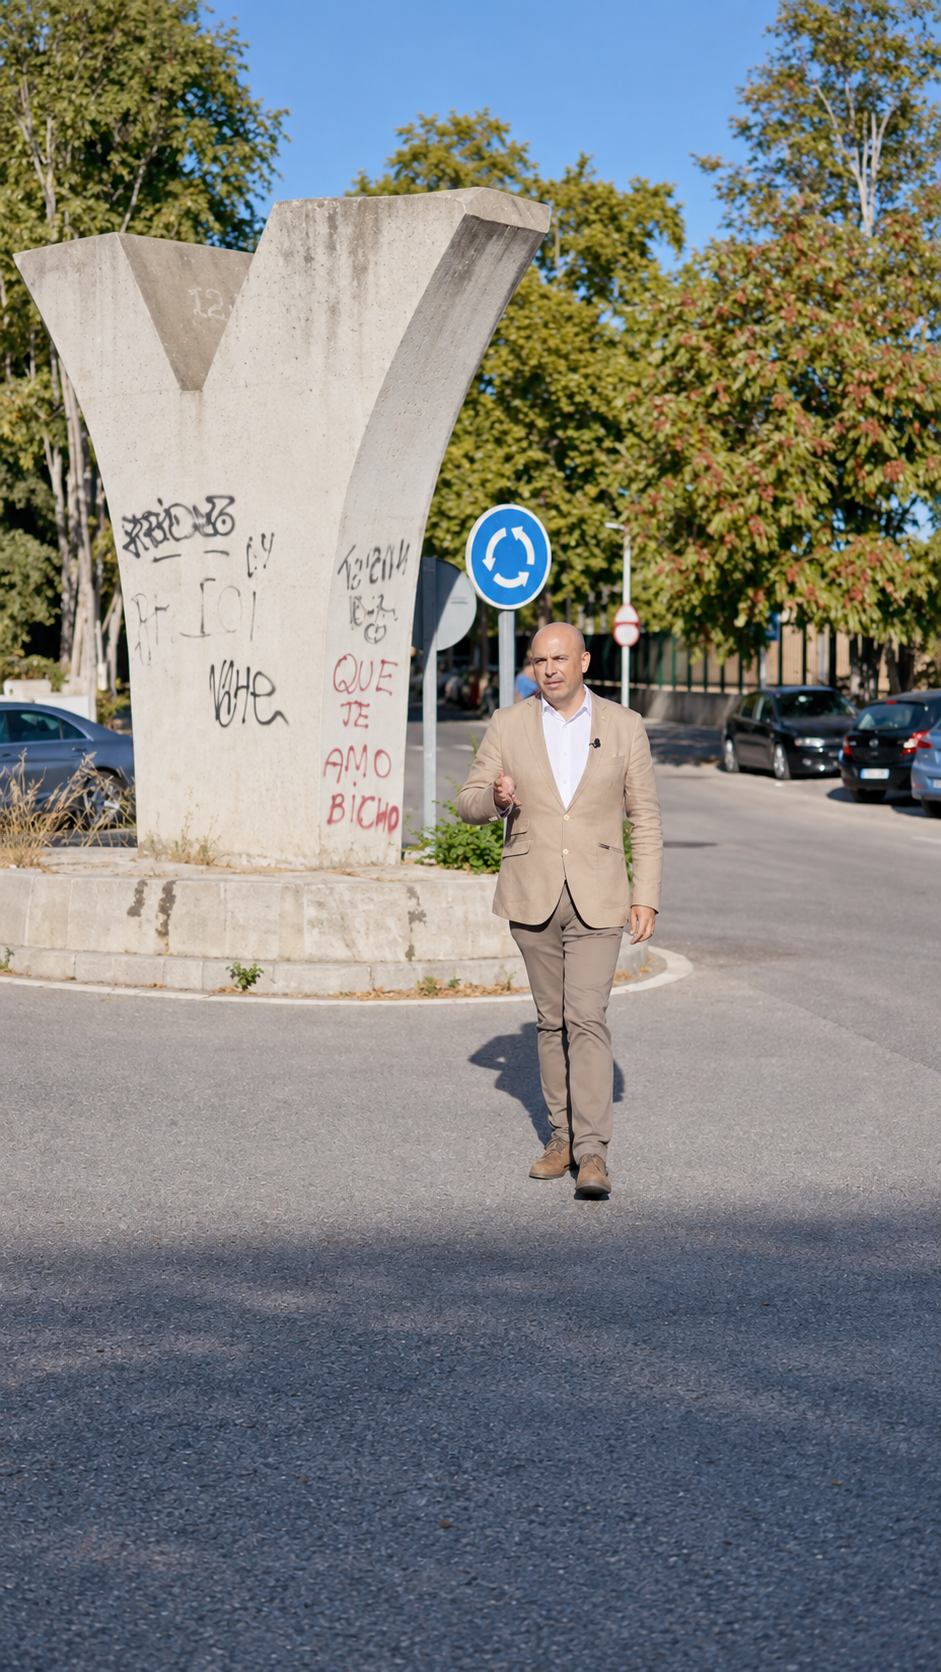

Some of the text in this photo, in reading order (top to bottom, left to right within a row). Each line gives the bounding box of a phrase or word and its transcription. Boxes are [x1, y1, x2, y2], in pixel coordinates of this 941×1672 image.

[333, 653, 398, 696] QUE
[323, 744, 392, 784] AMO
[327, 781, 400, 834] BICHO
